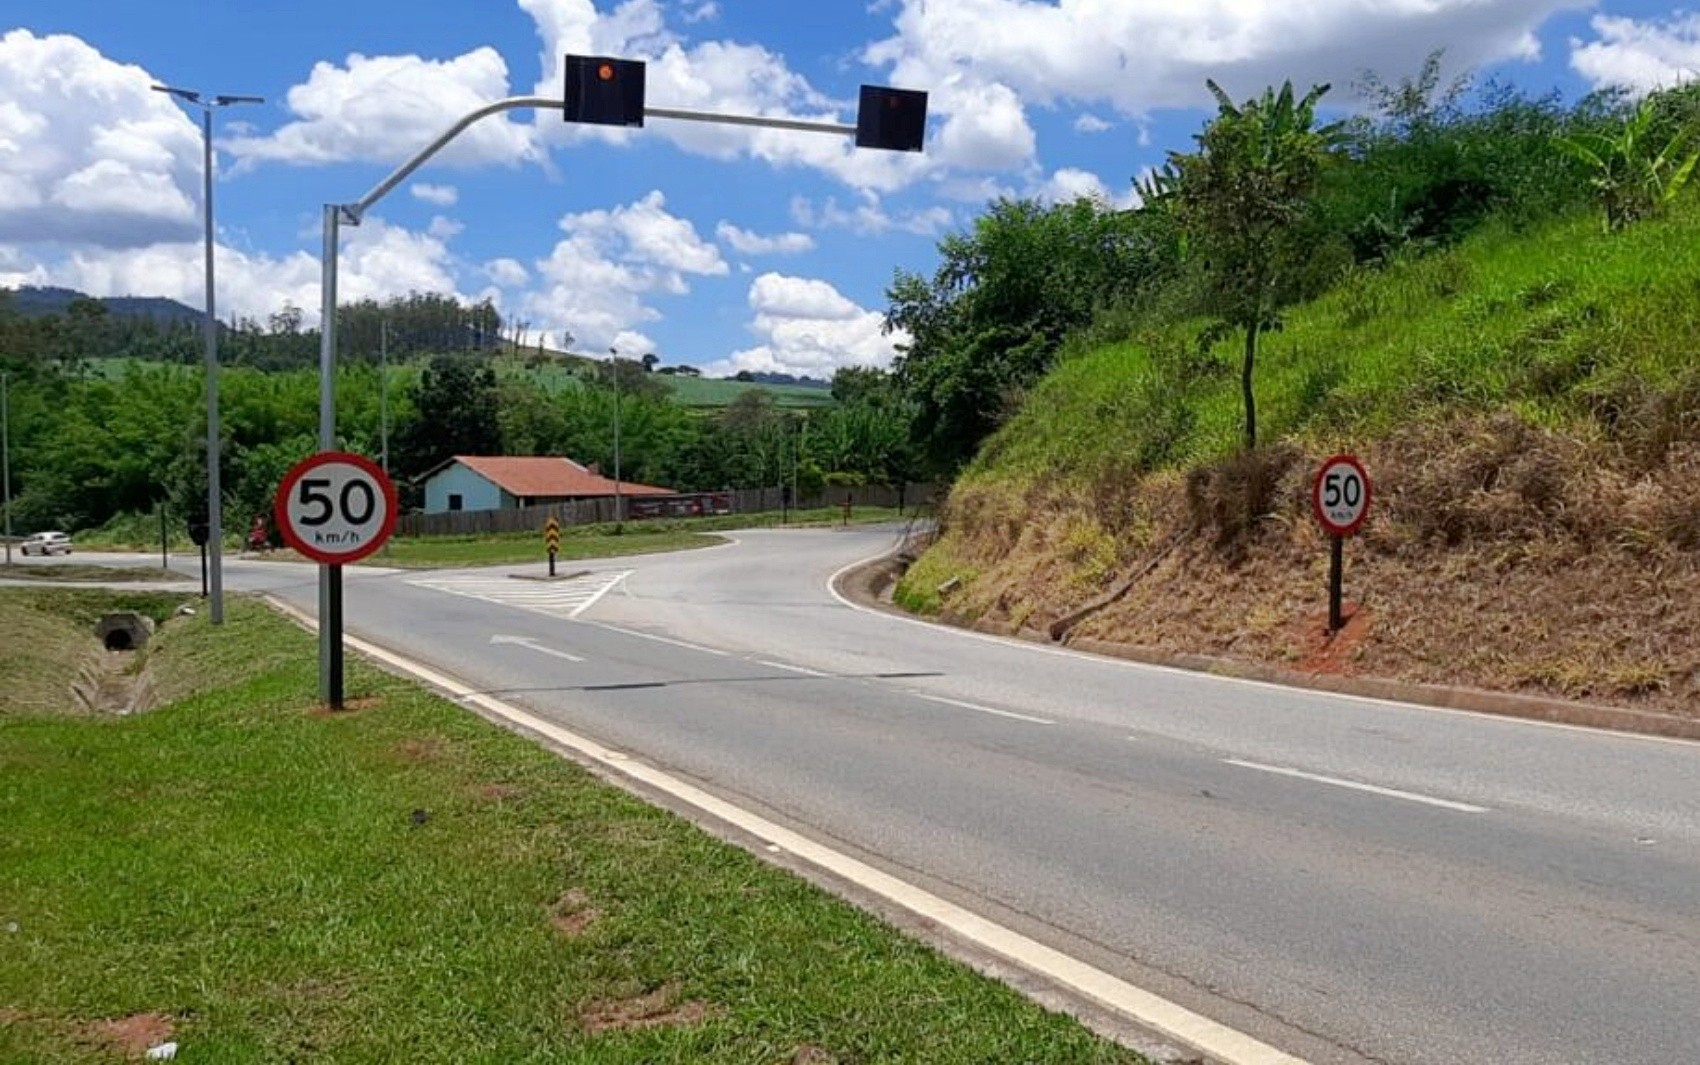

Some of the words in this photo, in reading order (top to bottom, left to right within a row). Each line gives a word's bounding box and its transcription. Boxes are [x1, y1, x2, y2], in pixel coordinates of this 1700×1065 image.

[300, 479, 375, 526] 50
[1325, 474, 1361, 507] 50
[314, 531, 360, 543] km/h
